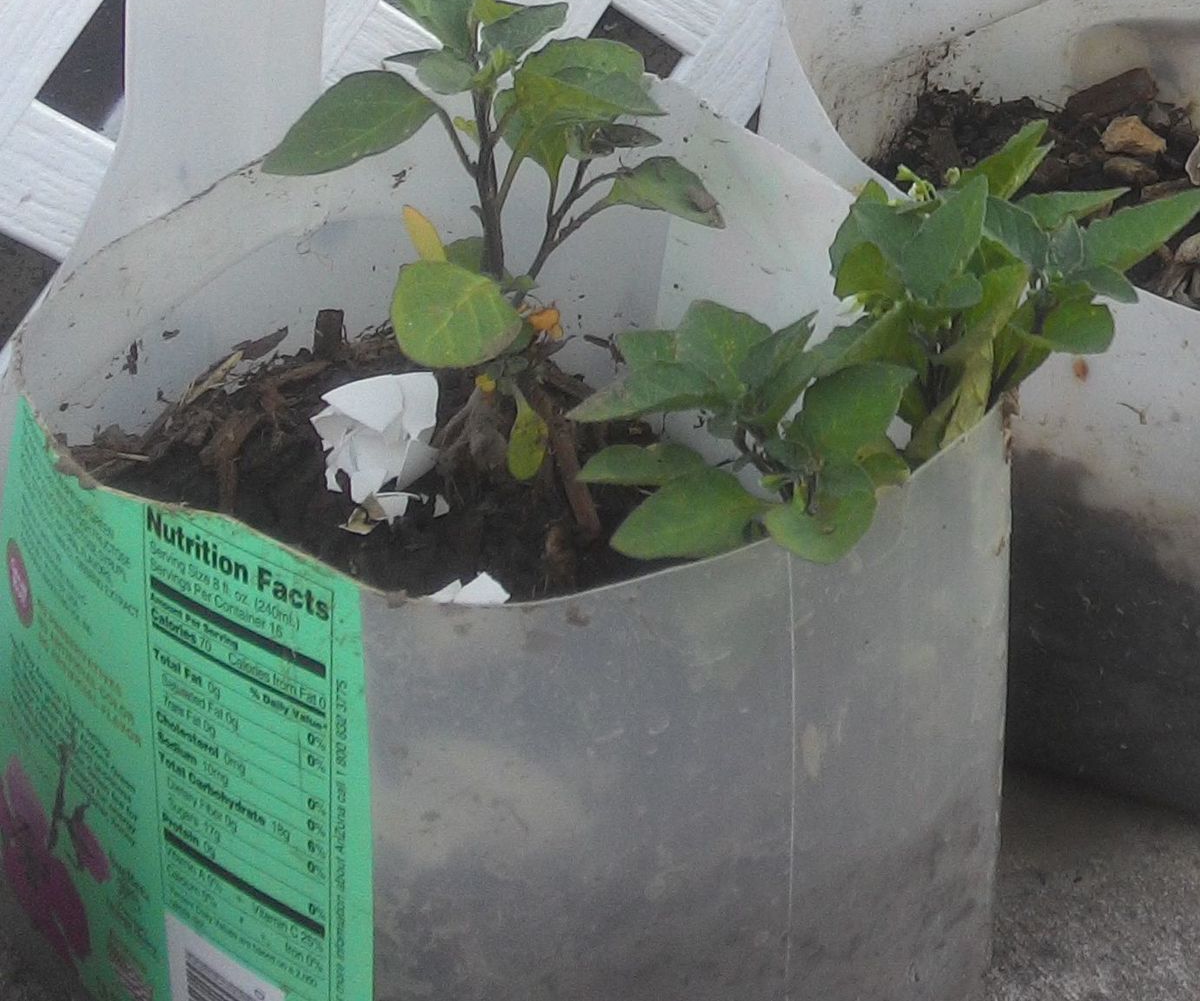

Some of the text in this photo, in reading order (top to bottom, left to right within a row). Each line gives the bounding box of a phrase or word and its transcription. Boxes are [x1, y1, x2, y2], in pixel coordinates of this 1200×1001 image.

[147, 506, 330, 621] Nutrition Facts
[151, 608, 197, 644] Calories
[214, 594, 266, 629] Container
